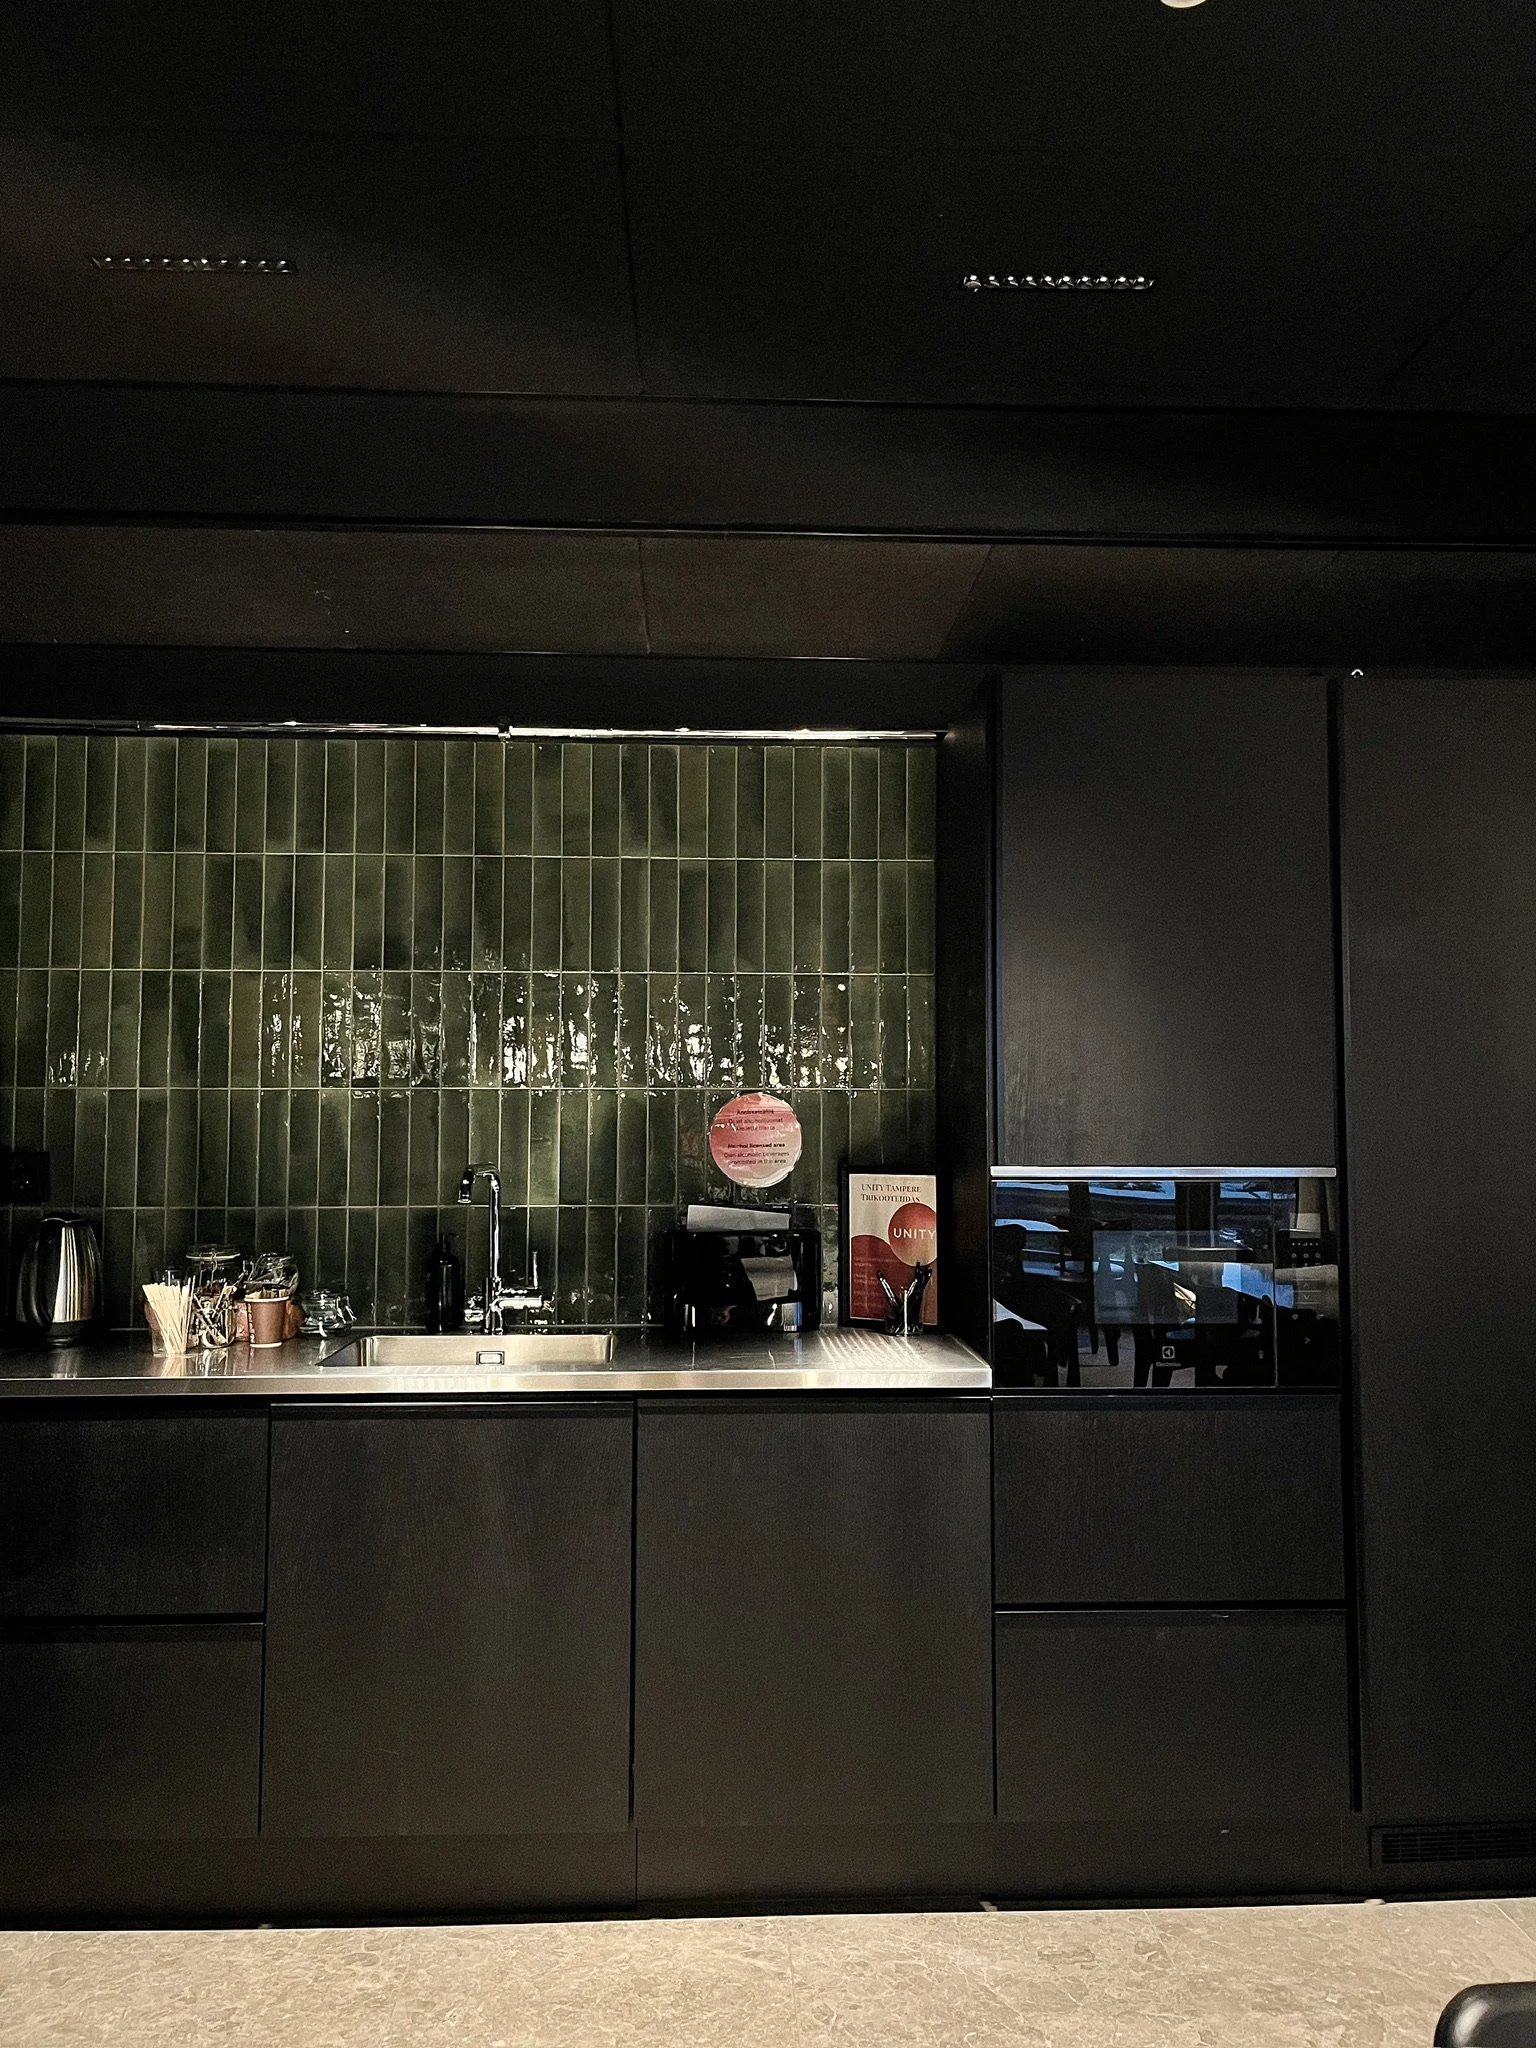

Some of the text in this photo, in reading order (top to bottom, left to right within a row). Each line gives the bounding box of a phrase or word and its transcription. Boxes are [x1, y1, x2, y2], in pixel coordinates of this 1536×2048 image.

[861, 1183, 922, 1193] UNITY TAMPERE
[861, 1193, 921, 1203] TRIKOOTEHDAS
[893, 1227, 936, 1240] UNITY
